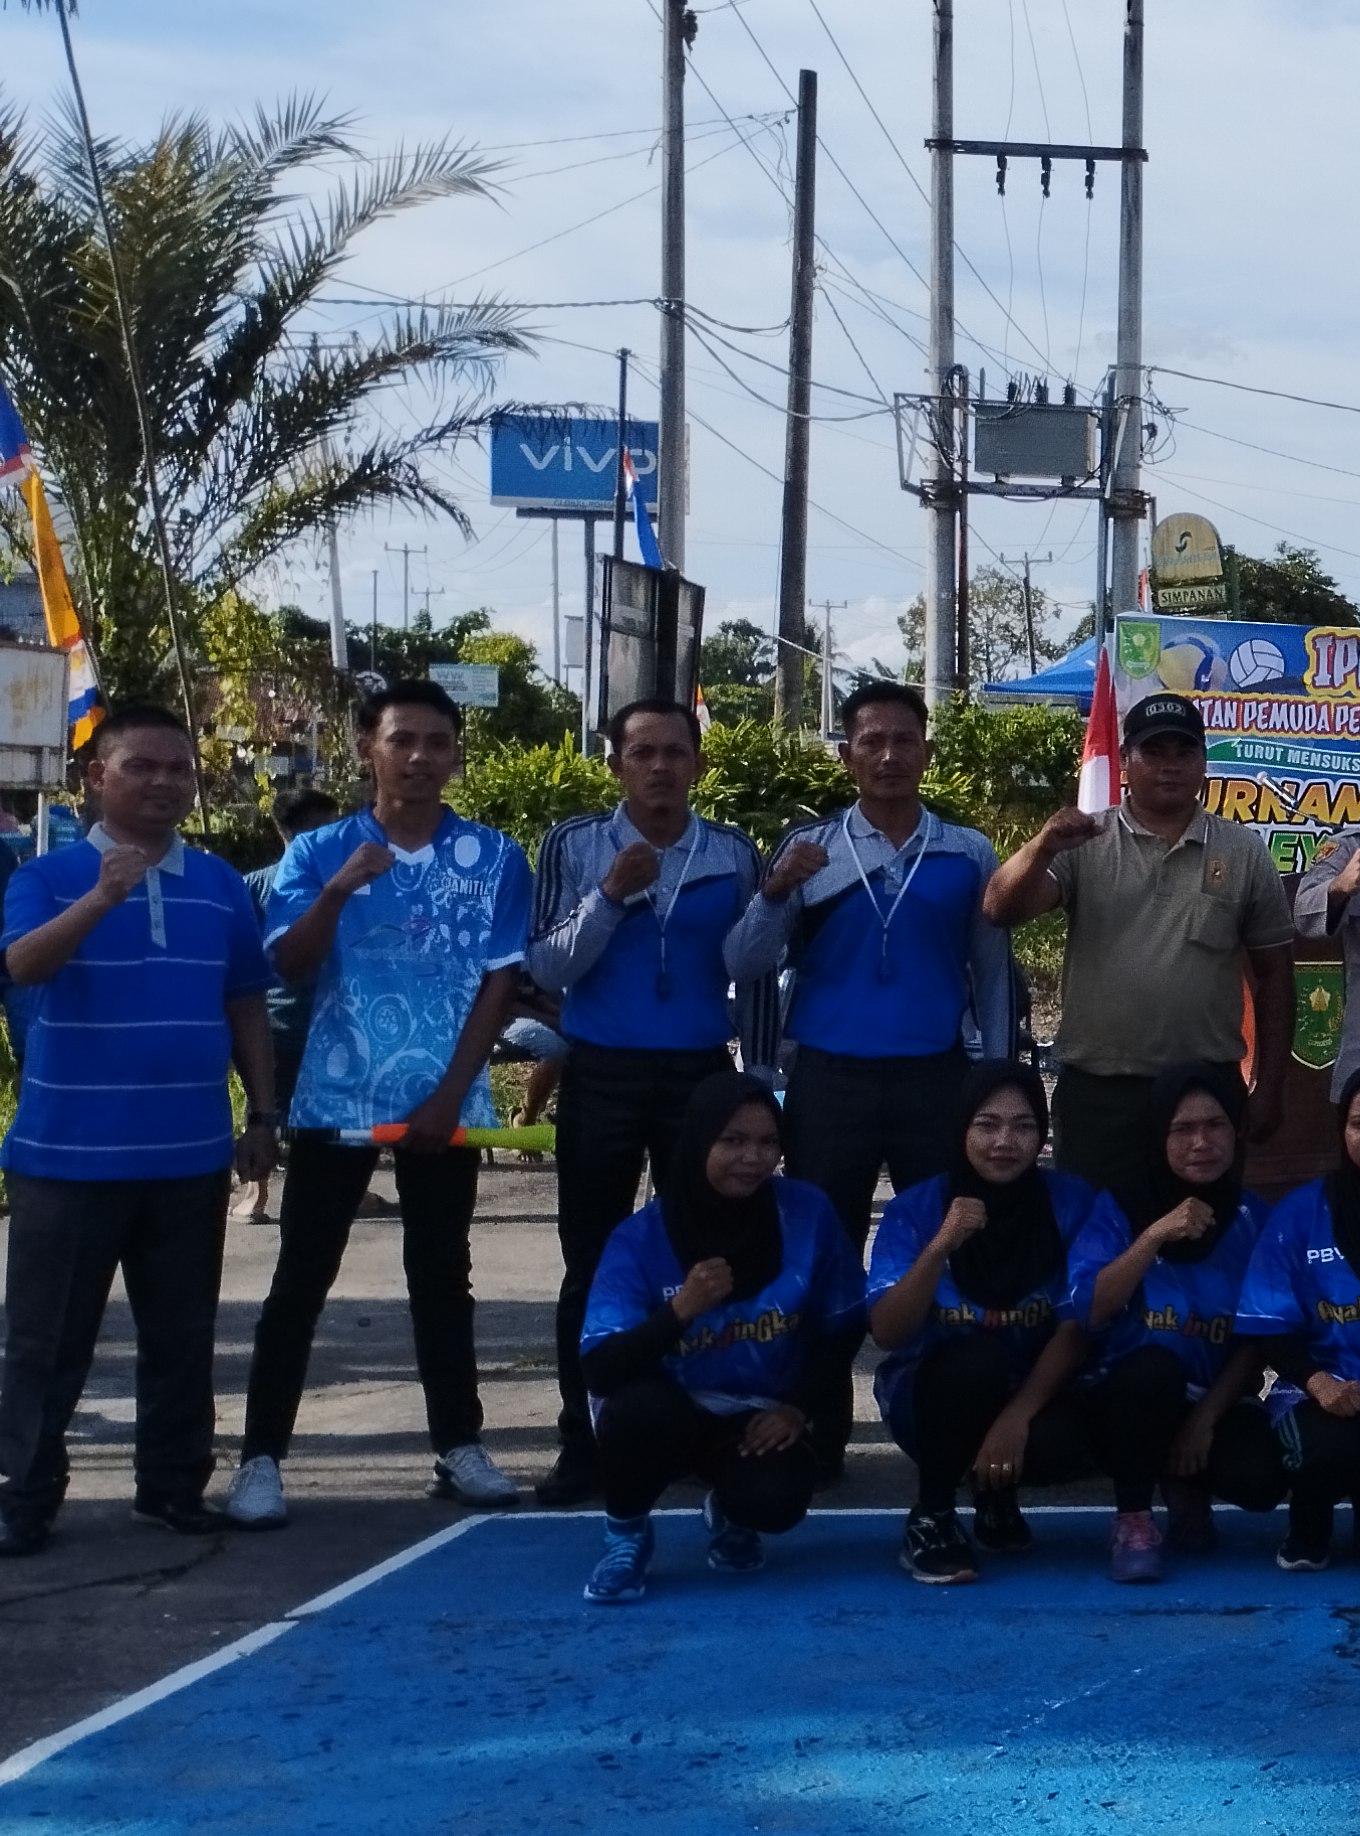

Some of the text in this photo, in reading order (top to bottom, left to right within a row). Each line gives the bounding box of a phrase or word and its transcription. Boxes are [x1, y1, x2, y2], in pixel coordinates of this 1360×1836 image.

[520, 437, 657, 475] vivo
[1194, 699, 1238, 729] TAN
[1244, 700, 1330, 733] PEMUDA
[1235, 742, 1284, 762] TURUT
